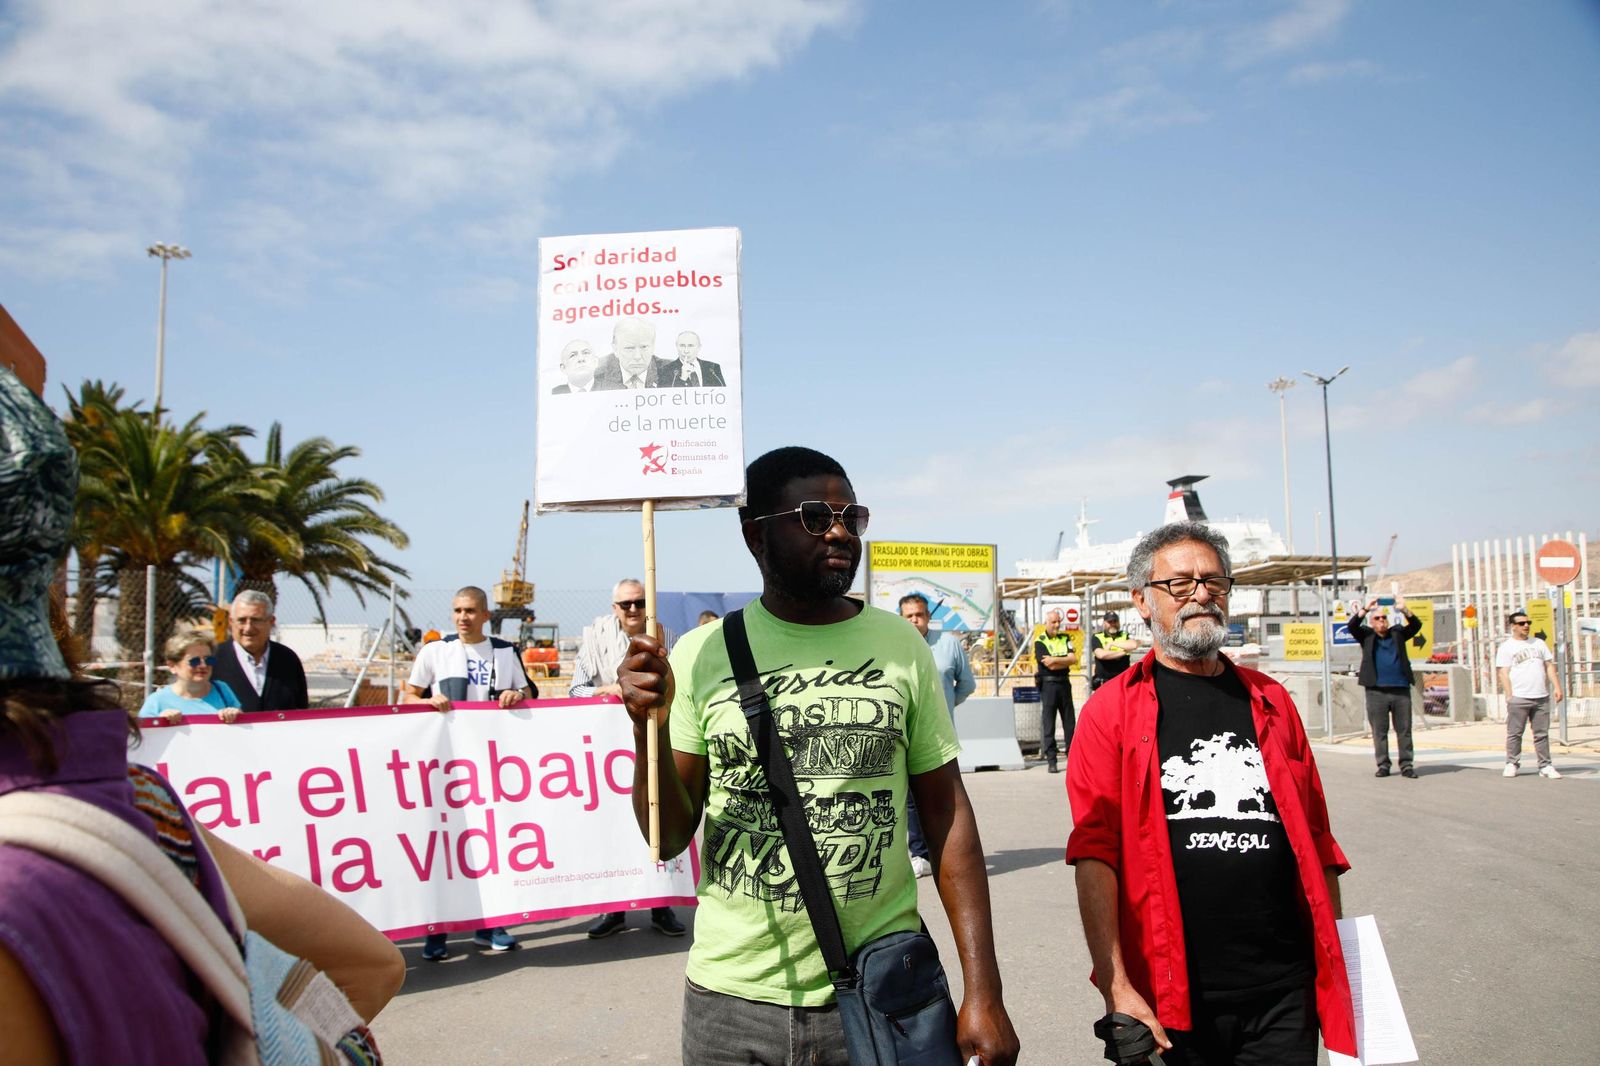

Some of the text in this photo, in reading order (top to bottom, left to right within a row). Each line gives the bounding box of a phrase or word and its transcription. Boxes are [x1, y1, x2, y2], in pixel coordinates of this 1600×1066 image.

[596, 274, 628, 292] los
[635, 270, 723, 292] pueblos
[552, 297, 680, 324] agredidos...
[635, 393, 666, 410] por
[672, 389, 689, 406] el
[694, 389, 727, 406] trío
[608, 413, 727, 432] de la muerte
[670, 439, 718, 448] Unificación
[671, 451, 729, 462] Comunista de
[671, 466, 703, 476] España
[873, 545, 989, 557] TRASLADO DE PARKING POR OBRAS
[872, 558, 898, 567] ACCESO
[899, 558, 912, 567] POR
[913, 559, 942, 568] ROTONDA
[943, 559, 951, 568] DE
[1289, 638, 1319, 646] CORTADO
[297, 747, 368, 819] el
[386, 734, 638, 812] trabajo
[305, 807, 554, 893] la vida
[1185, 830, 1270, 854] SENEGAL
